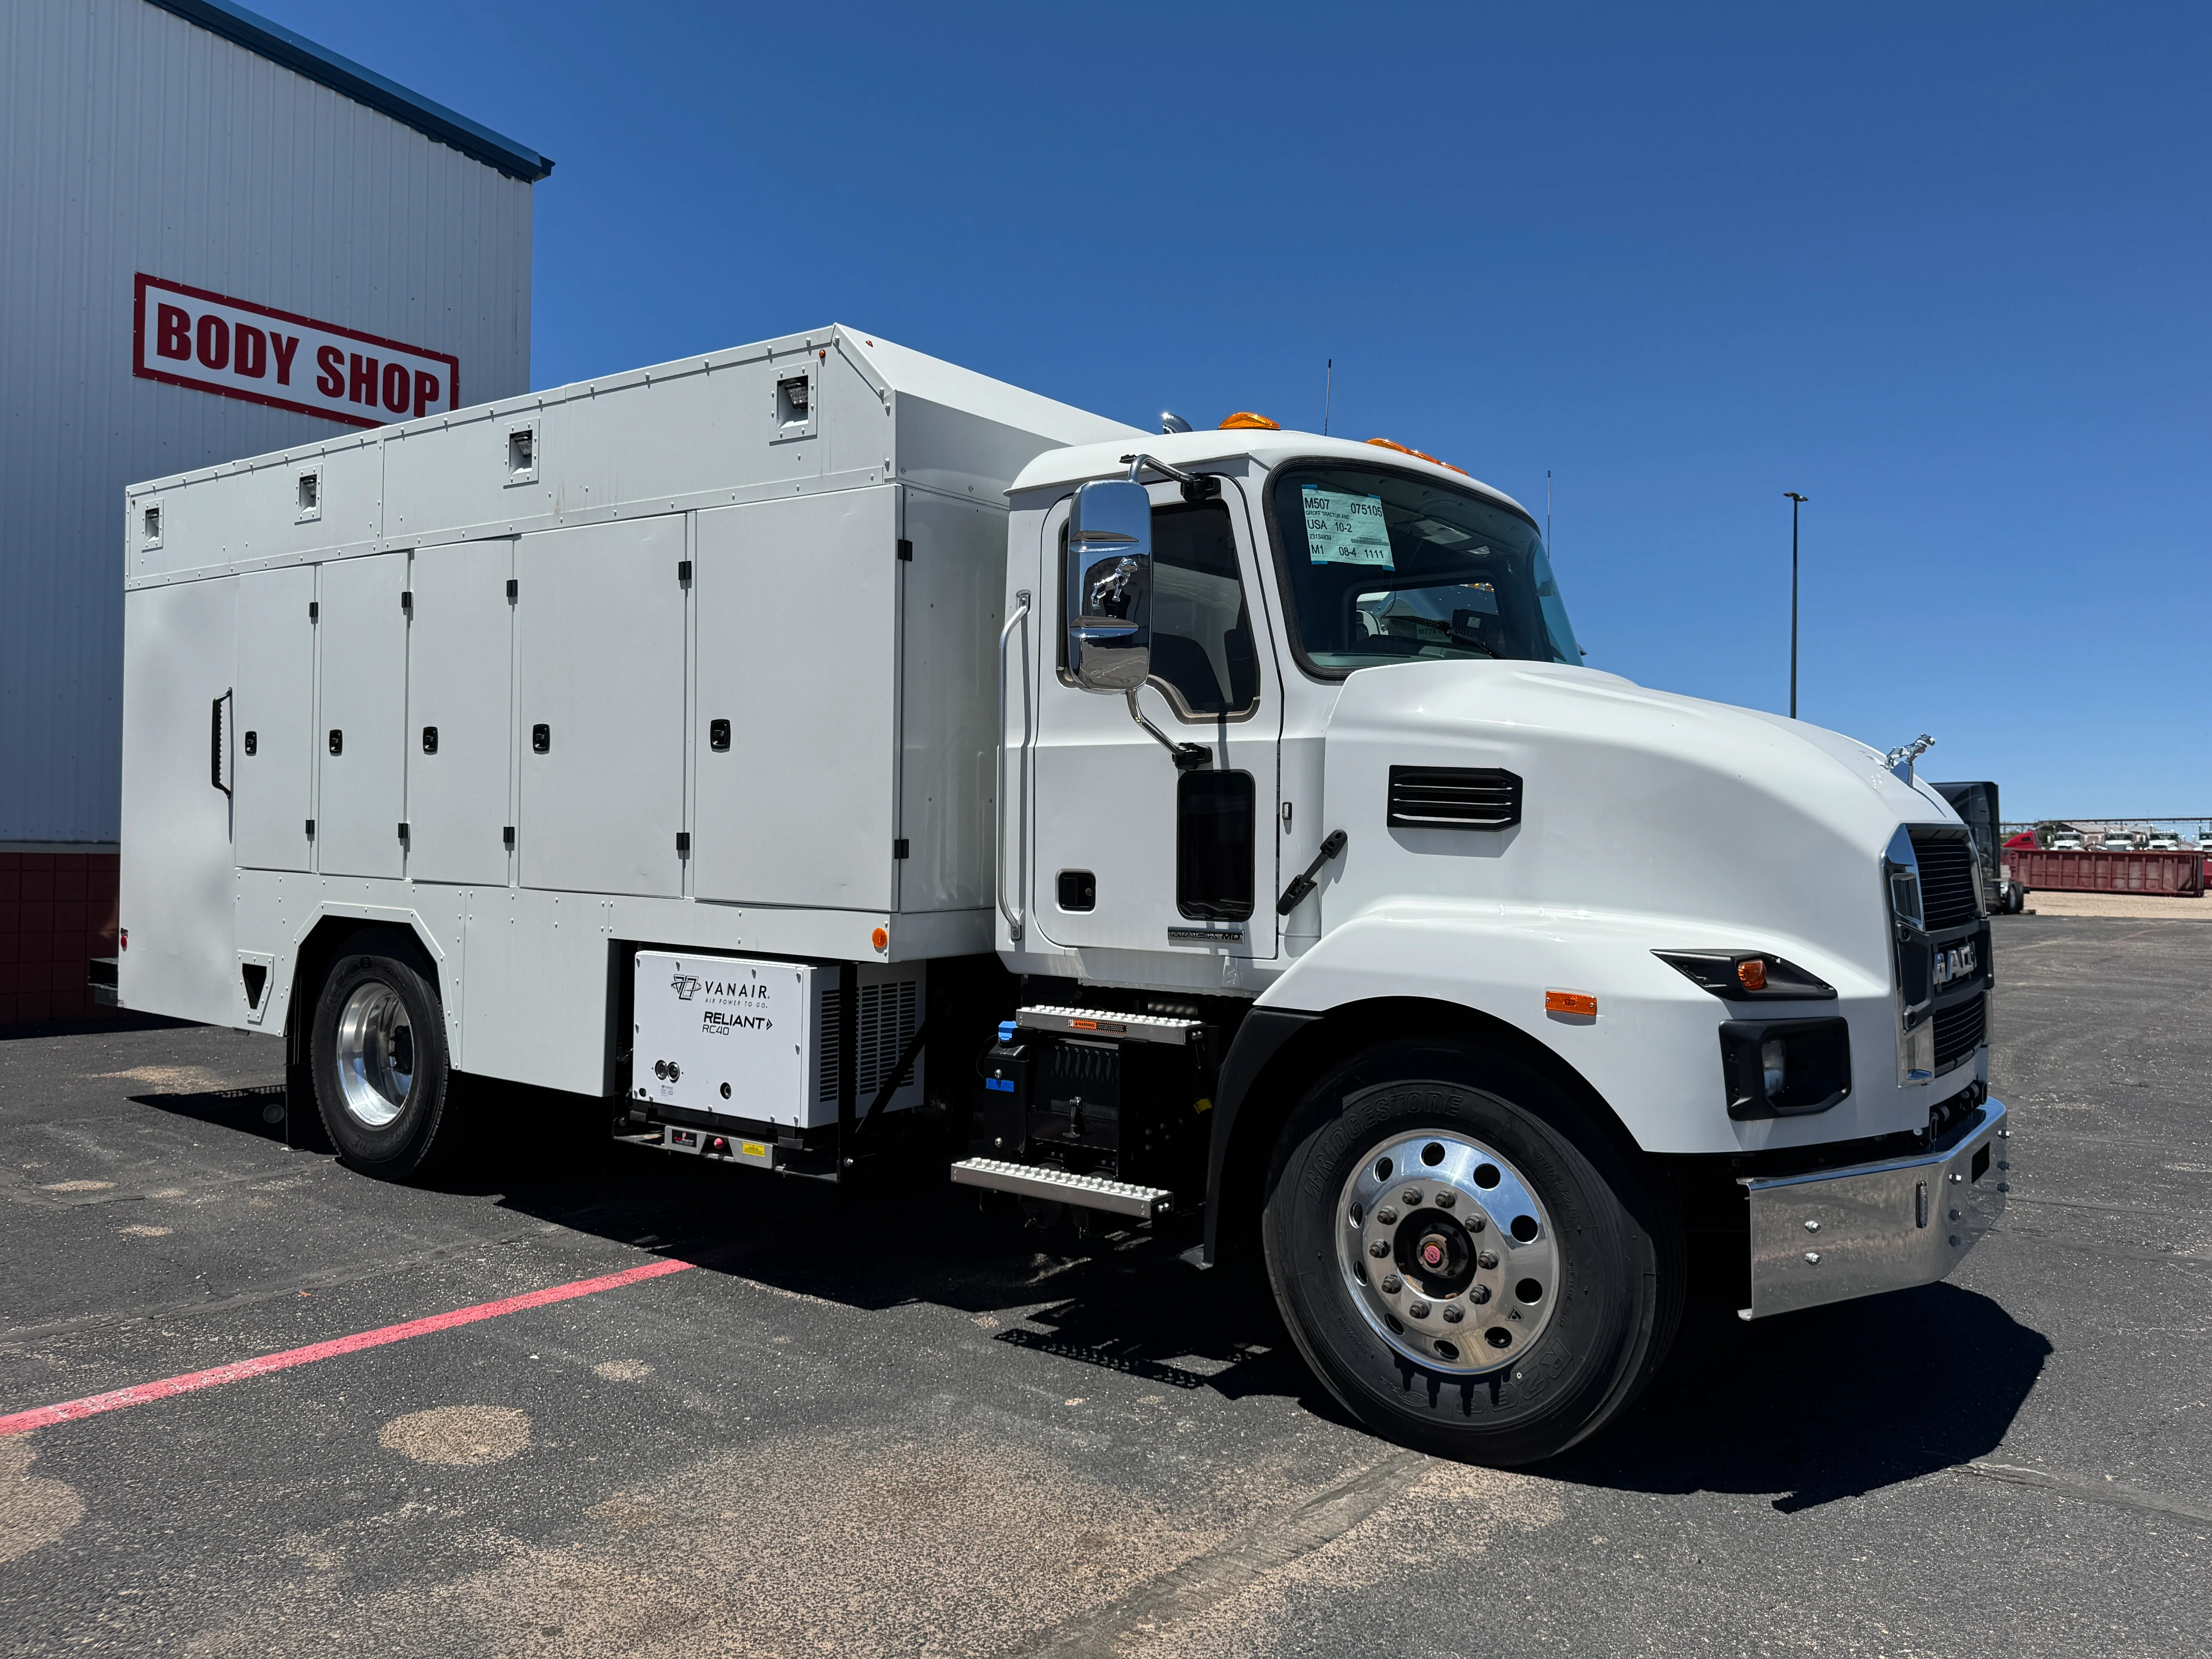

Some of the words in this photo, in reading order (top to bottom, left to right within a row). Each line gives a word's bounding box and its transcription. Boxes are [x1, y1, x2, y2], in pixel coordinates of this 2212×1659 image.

[157, 302, 299, 386] BODY
[316, 345, 440, 417] SHOP
[1305, 497, 1329, 510] M507
[1351, 503, 1382, 517] 075105
[1307, 519, 1327, 530] USA
[1335, 522, 1352, 532] 10-2
[1311, 544, 1324, 555] M1
[1339, 546, 1357, 557] 08-4
[1364, 549, 1384, 559] 1111
[1170, 930, 1218, 939] MACK
[1933, 941, 1977, 985] MAC
[705, 981, 767, 999] VANAIR
[704, 1011, 765, 1029] RELIANT
[702, 1024, 729, 1035] RC40
[1304, 1091, 1463, 1204] BRIDGESTONE
